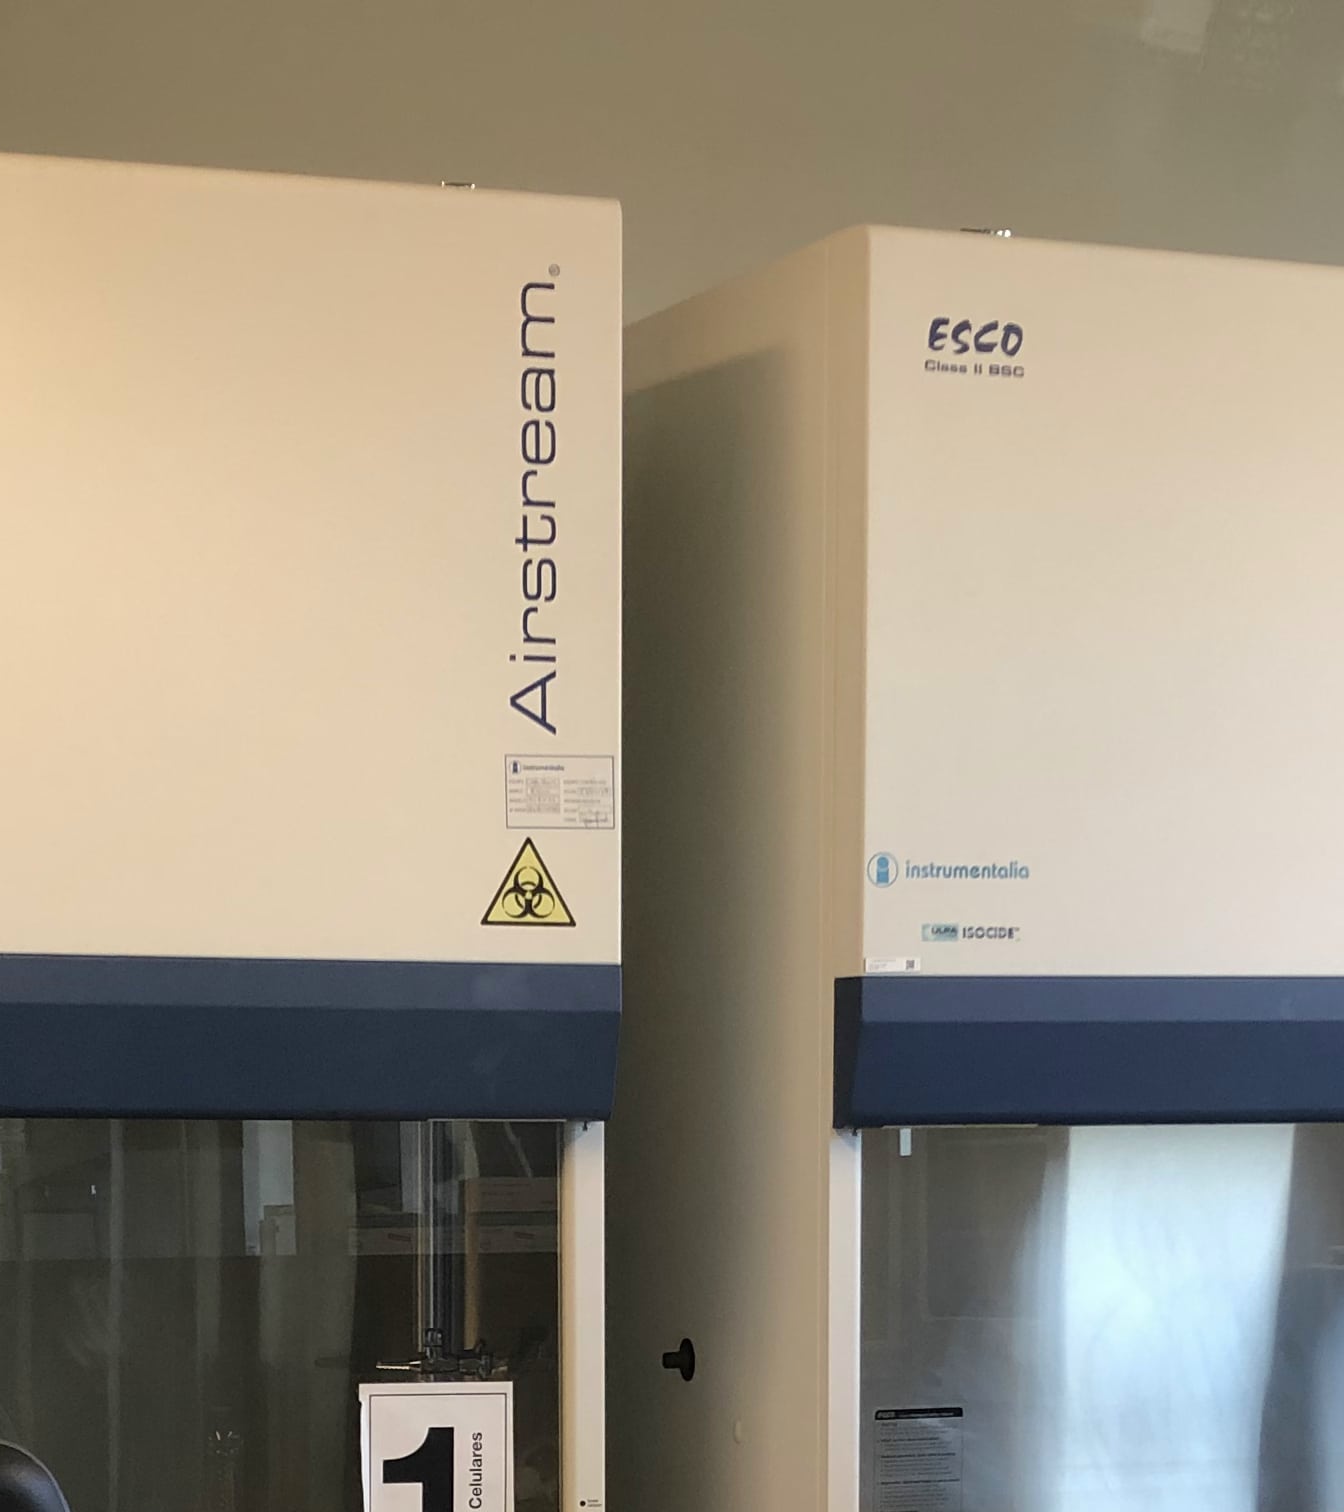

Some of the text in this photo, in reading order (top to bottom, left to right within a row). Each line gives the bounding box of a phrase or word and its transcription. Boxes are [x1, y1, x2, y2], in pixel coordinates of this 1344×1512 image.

[927, 316, 1024, 357] ESCO
[508, 280, 557, 736] Airstream
[904, 858, 1030, 880] instrumentalia
[468, 1432, 483, 1509] Celulares
